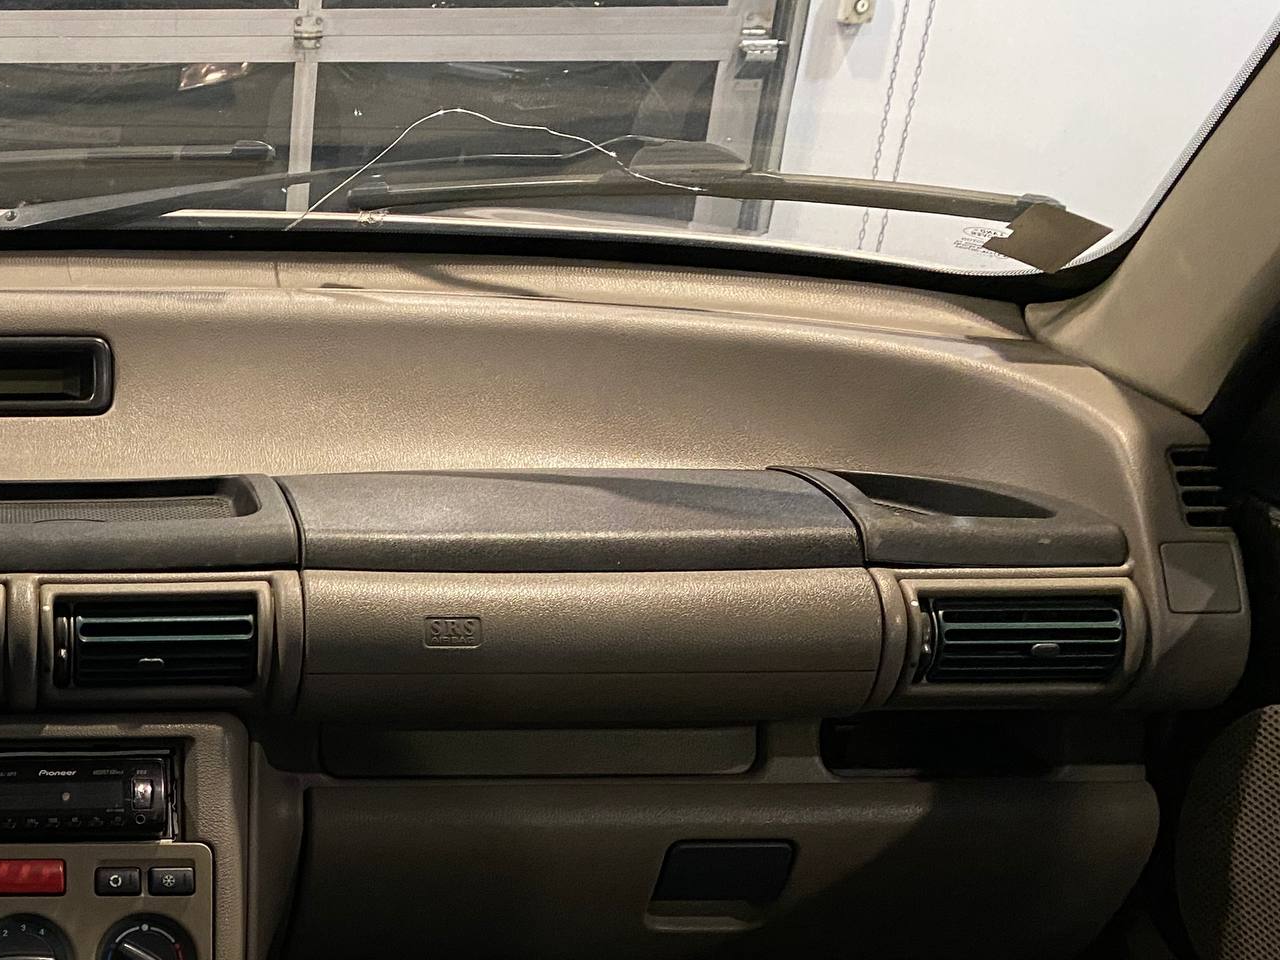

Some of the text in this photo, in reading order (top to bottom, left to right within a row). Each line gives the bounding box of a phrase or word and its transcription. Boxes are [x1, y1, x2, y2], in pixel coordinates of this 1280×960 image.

[431, 619, 474, 636] SRS
[38, 769, 78, 777] Pioneer
[20, 923, 27, 932] 3
[2, 929, 9, 937] 2
[38, 928, 45, 936] 4
